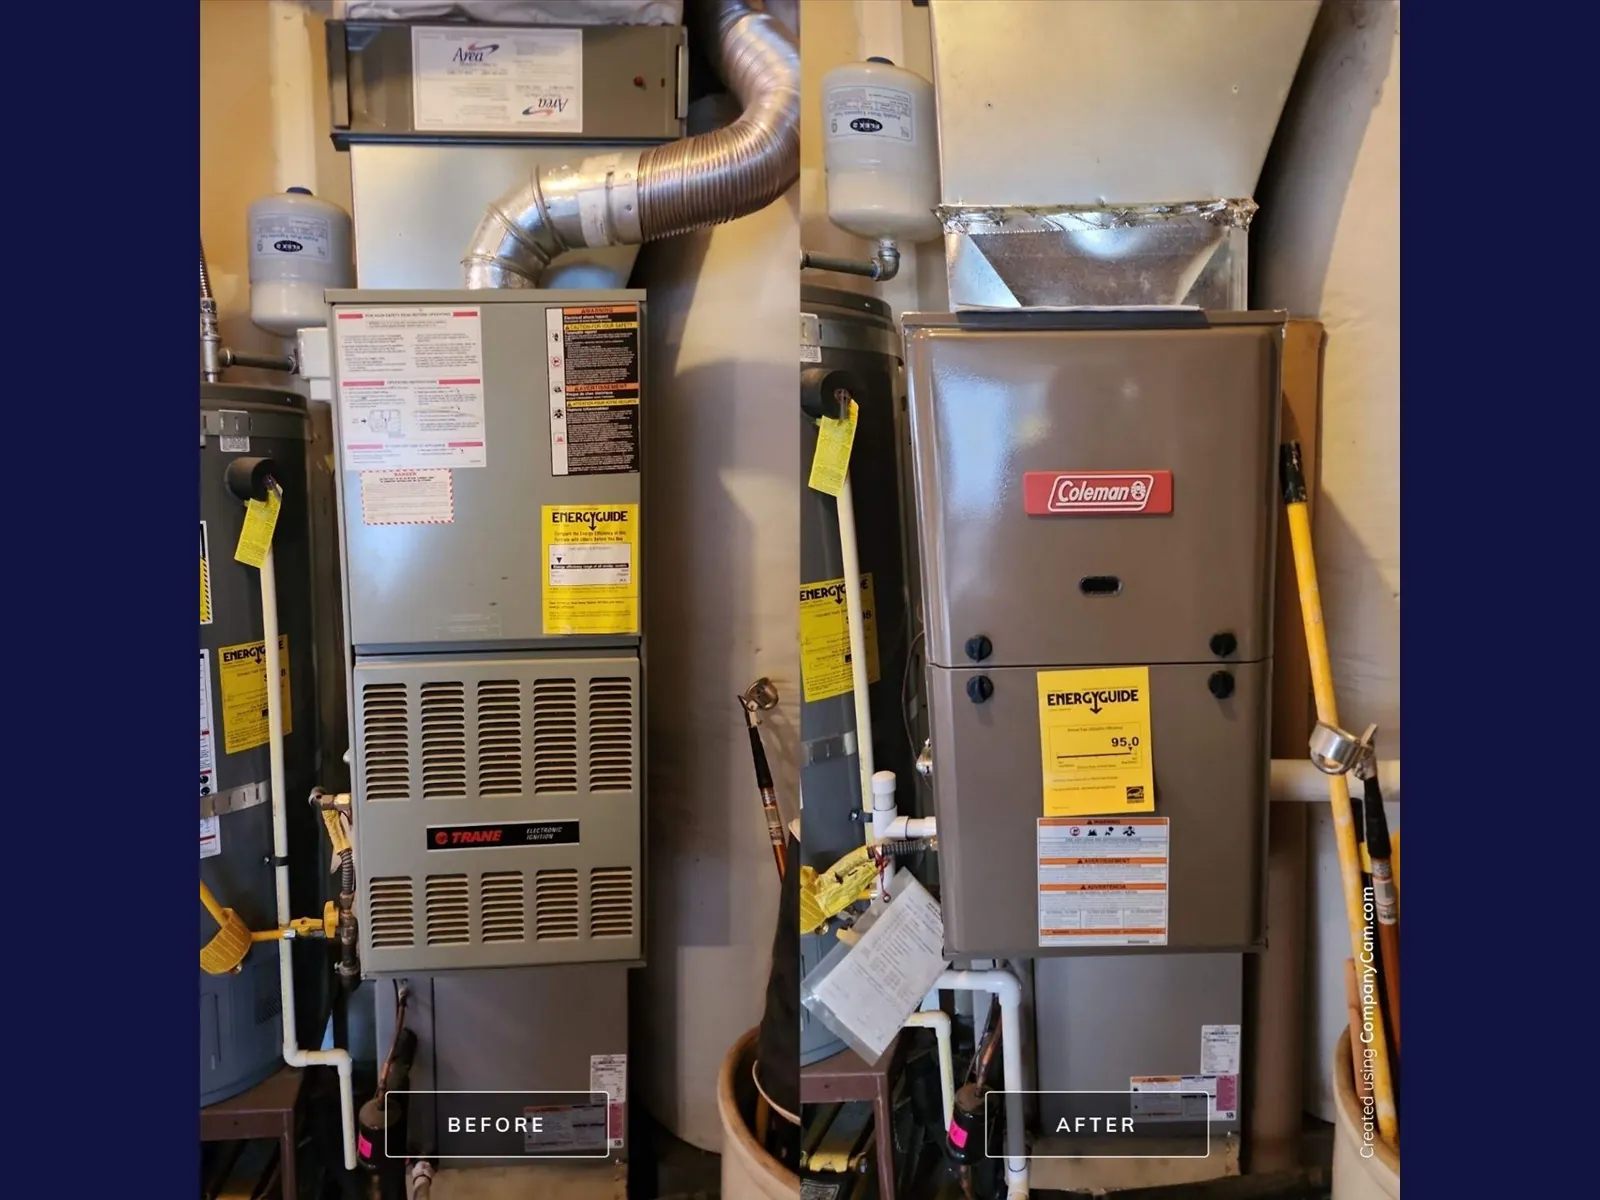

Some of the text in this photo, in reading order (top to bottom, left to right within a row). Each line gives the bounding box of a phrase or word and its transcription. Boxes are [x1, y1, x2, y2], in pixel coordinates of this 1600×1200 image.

[452, 47, 484, 62] Area
[538, 98, 569, 113] Area
[1058, 480, 1129, 502] Coleman
[552, 511, 628, 524] ENERGYGUIDE
[1047, 689, 1139, 706] ENERGYGUIDE
[1111, 737, 1139, 747] 95.0
[452, 831, 502, 843] TRANE
